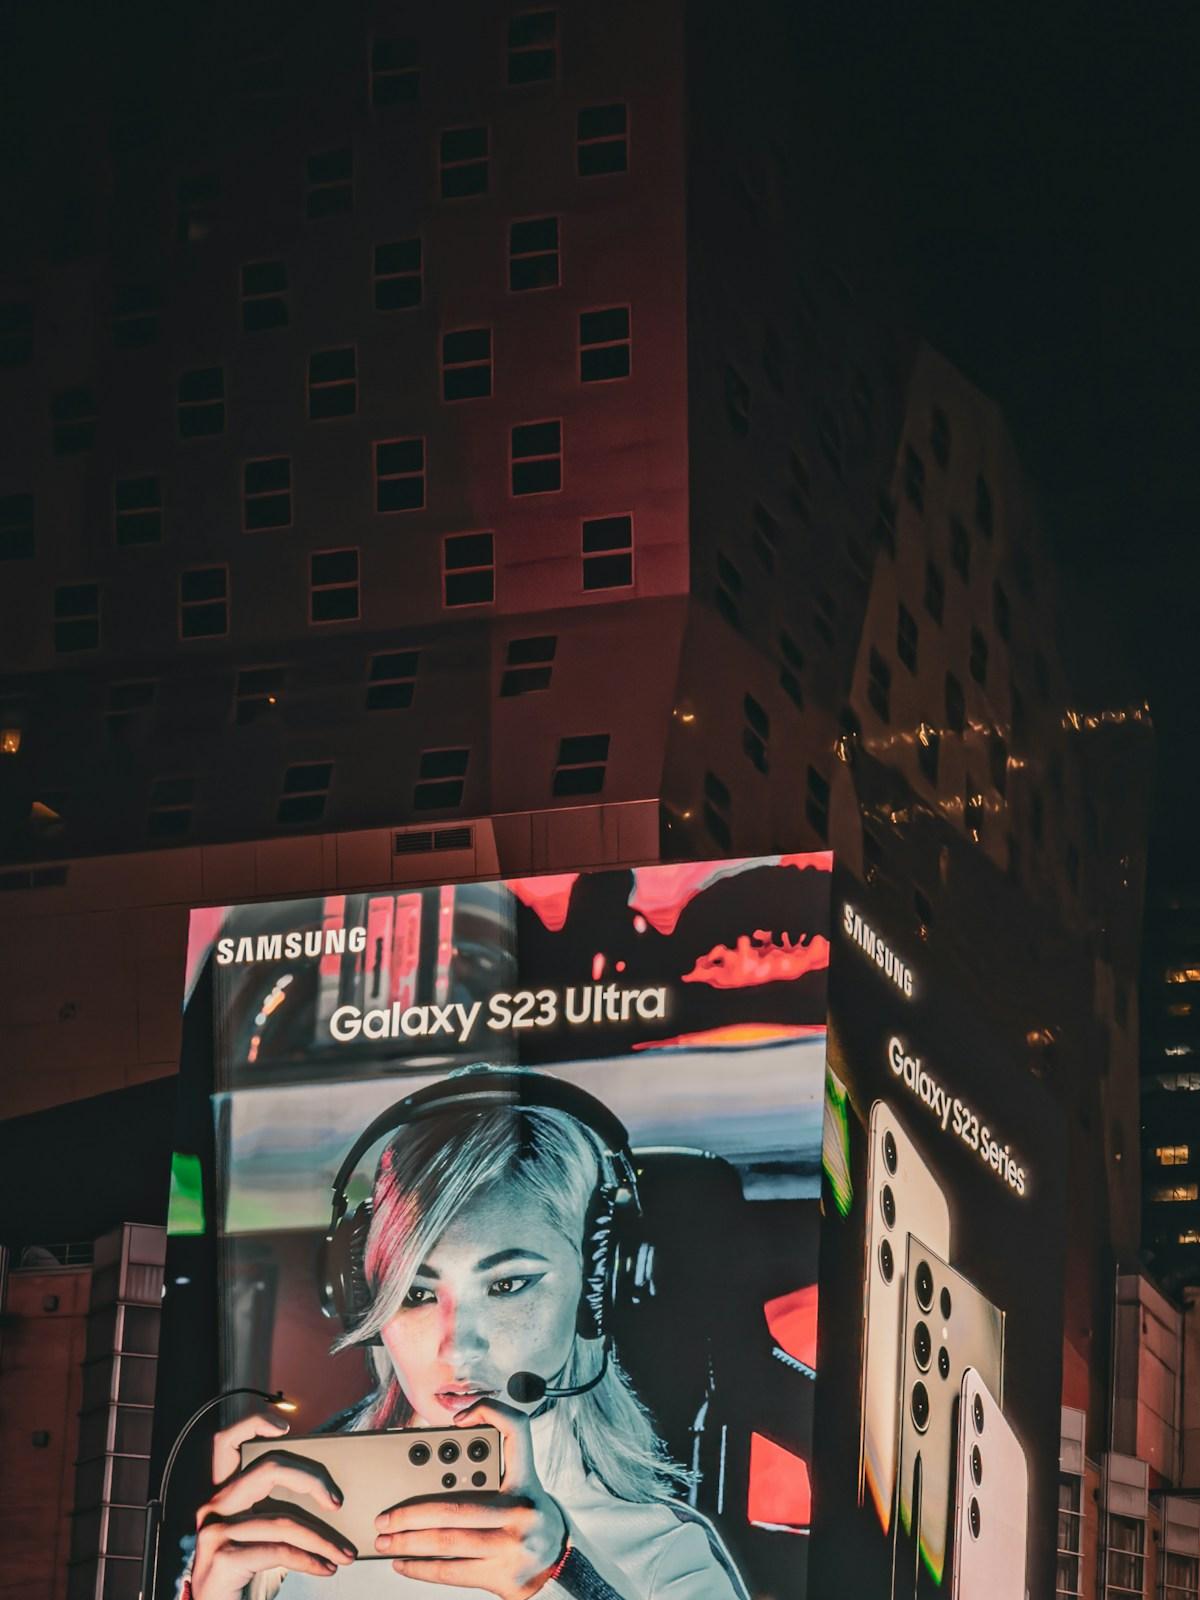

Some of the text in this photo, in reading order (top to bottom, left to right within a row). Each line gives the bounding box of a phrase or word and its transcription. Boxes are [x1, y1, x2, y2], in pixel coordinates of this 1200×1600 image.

[217, 926, 367, 966] SAMSUNG
[843, 902, 913, 998] SAMSUNG
[329, 985, 667, 1041] Galaxy S23 Ultra
[888, 1036, 1026, 1197] Galaxy S23 Series
